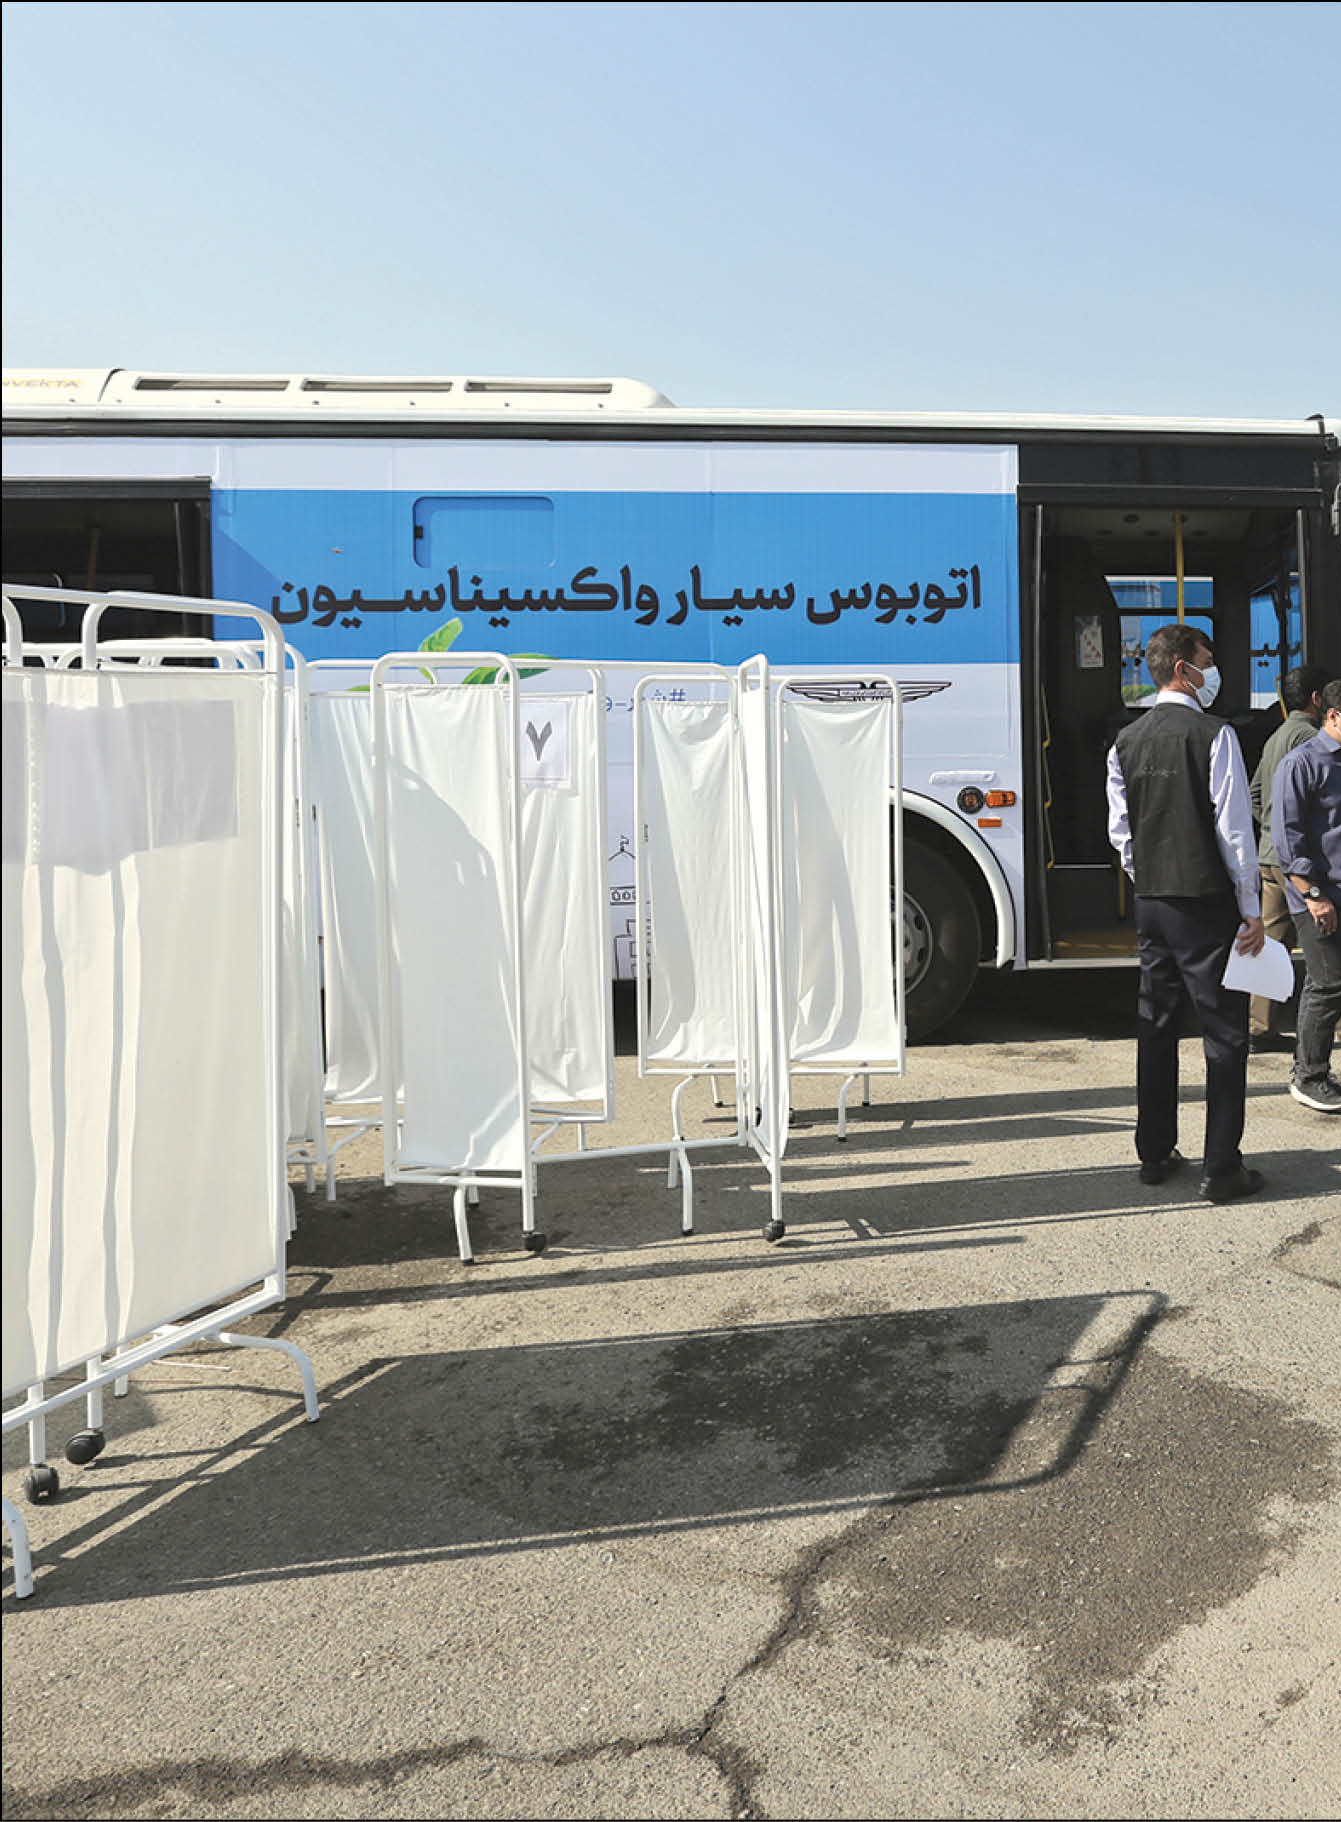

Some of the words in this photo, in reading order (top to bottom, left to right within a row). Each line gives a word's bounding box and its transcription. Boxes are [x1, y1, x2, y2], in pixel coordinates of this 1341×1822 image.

[270, 564, 660, 629] واکسیناسیون
[665, 564, 796, 628] سیار
[806, 563, 981, 626] اتوبوس
[526, 721, 553, 761] ۷
